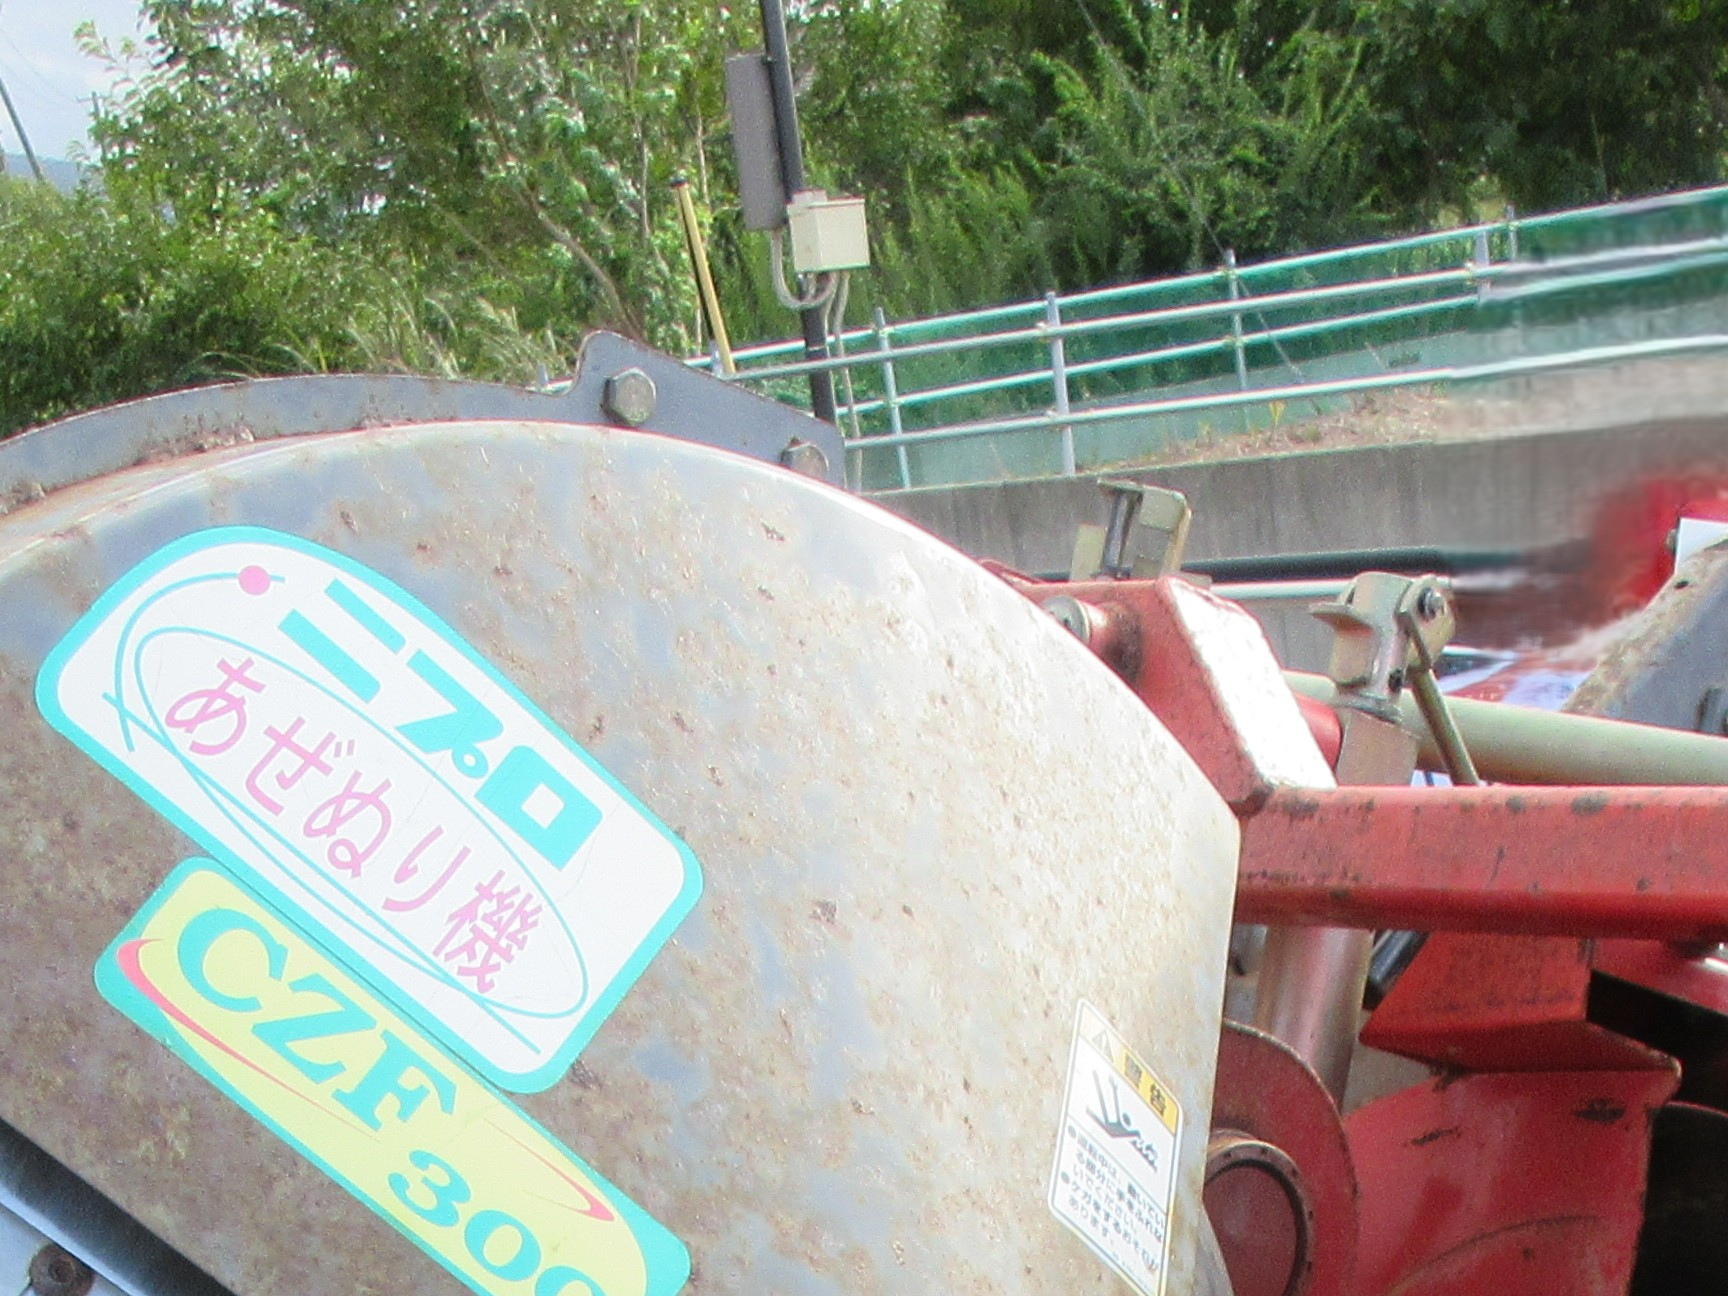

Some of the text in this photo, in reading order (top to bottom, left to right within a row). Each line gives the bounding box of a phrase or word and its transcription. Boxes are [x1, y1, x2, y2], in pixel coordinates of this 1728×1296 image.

[164, 655, 543, 994] あぜぬり機
[277, 578, 603, 871] ニプロ
